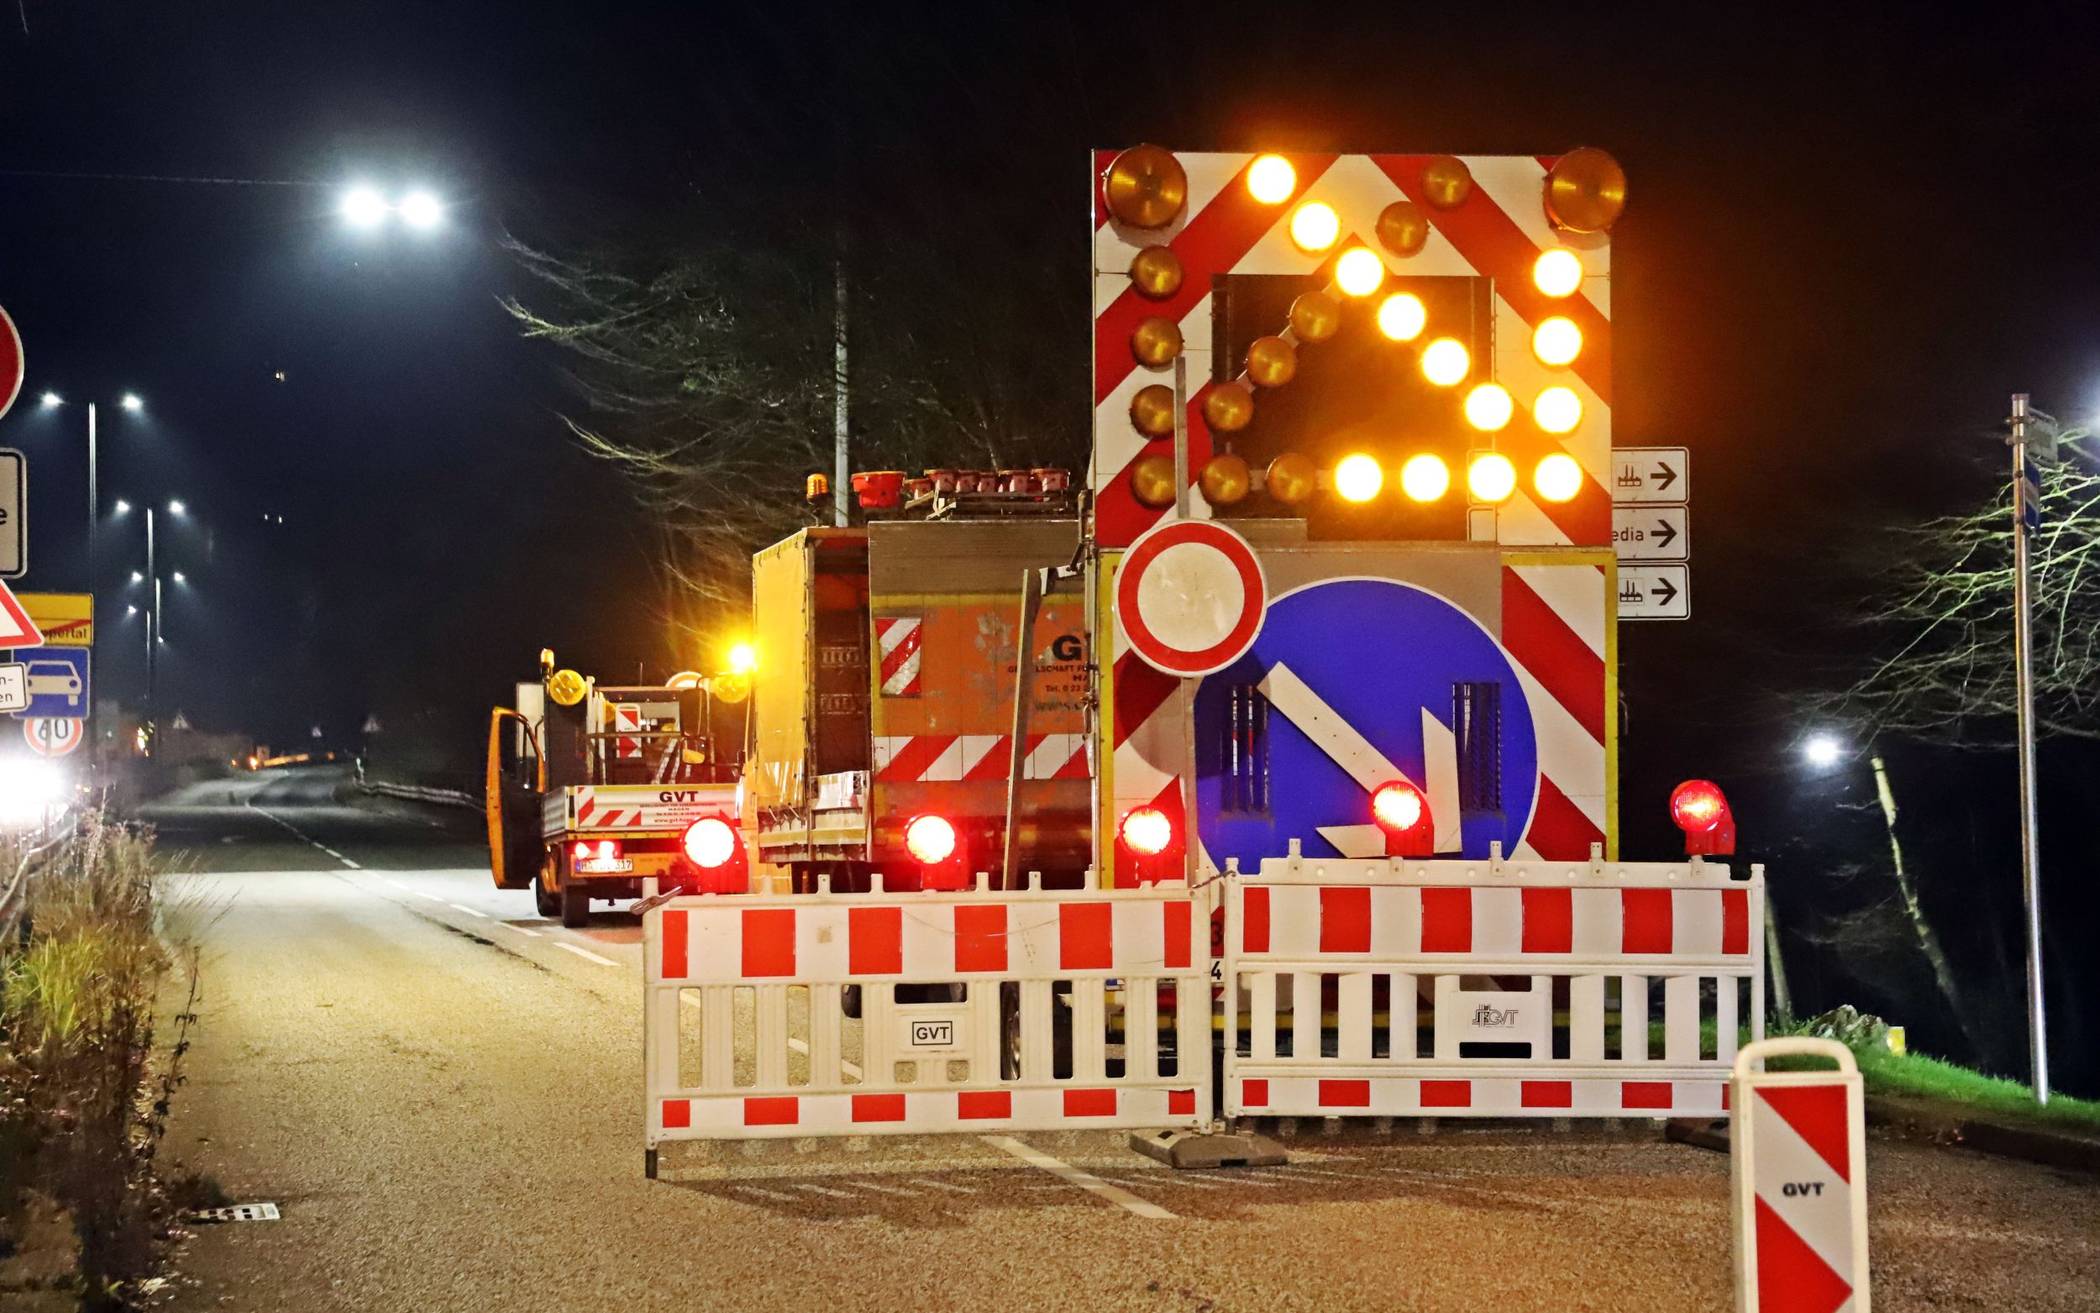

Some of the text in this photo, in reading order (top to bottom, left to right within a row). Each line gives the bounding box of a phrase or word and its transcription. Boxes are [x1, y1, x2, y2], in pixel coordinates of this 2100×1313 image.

[659, 791, 698, 803] GVT
[916, 1026, 950, 1040] GVT
[1782, 1182, 1825, 1197] GVT
